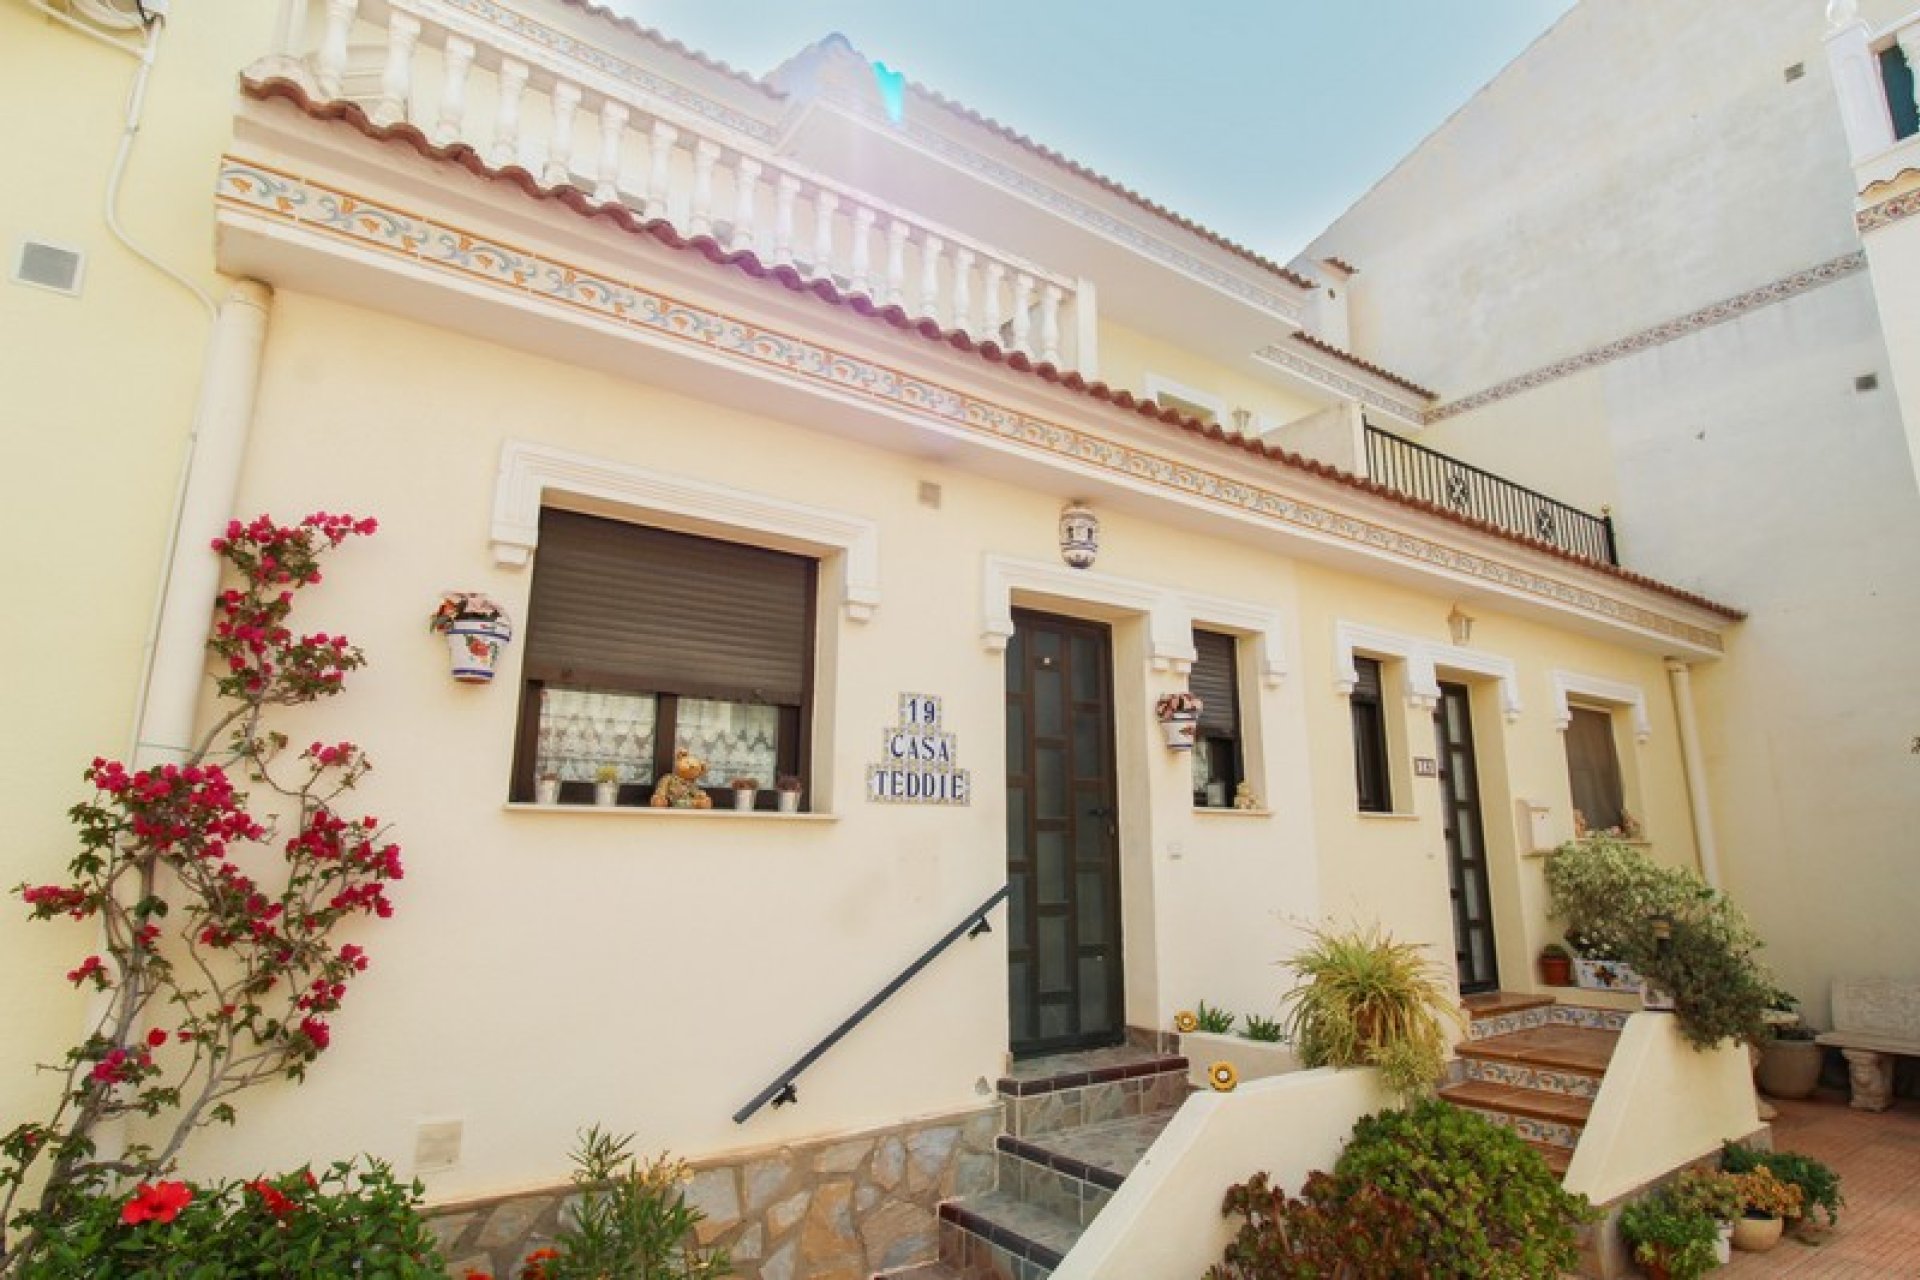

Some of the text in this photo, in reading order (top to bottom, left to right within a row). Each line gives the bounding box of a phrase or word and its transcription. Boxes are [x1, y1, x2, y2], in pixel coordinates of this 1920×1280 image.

[907, 698, 935, 723] 19
[890, 734, 949, 761] CASA
[875, 770, 964, 798] TEDDIE
